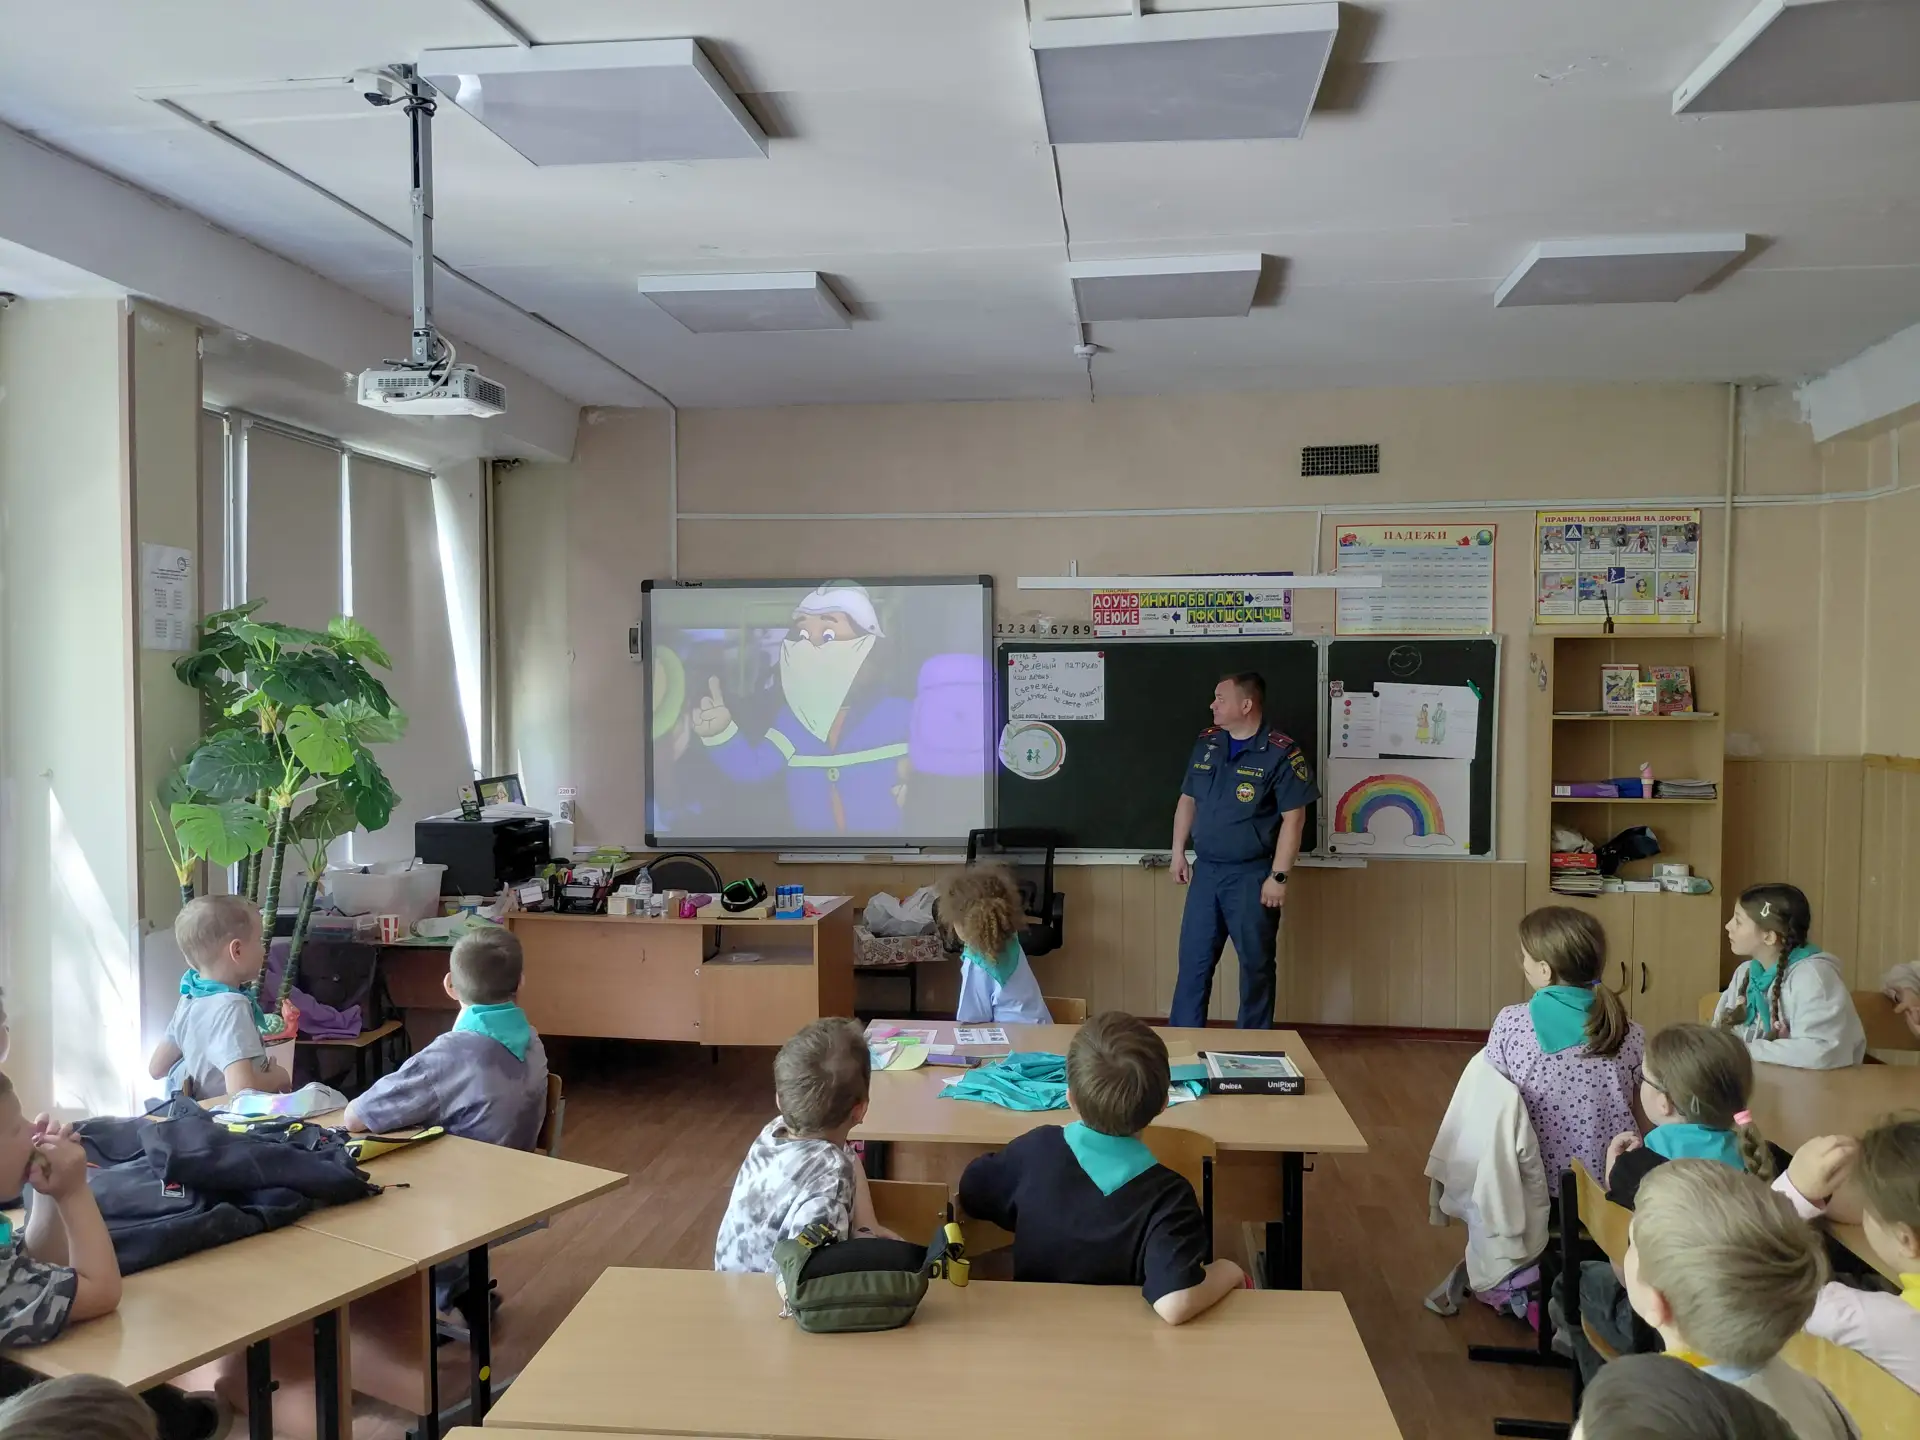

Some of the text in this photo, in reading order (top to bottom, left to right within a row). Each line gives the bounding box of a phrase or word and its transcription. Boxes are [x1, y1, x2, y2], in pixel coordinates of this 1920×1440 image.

[1589, 515, 1641, 523] ПОВЕДЕНИЯ
[1383, 530, 1448, 541] ПАДЕЖИ
[997, 624, 1004, 633] 1
[1008, 624, 1015, 633] 2
[1019, 624, 1026, 633] 3
[1029, 624, 1037, 634] 4
[1050, 625, 1058, 634] 6
[1061, 625, 1069, 634] 7
[1072, 625, 1080, 634] 8
[1083, 625, 1091, 634] 9
[1267, 1081, 1298, 1089] UniPixel
